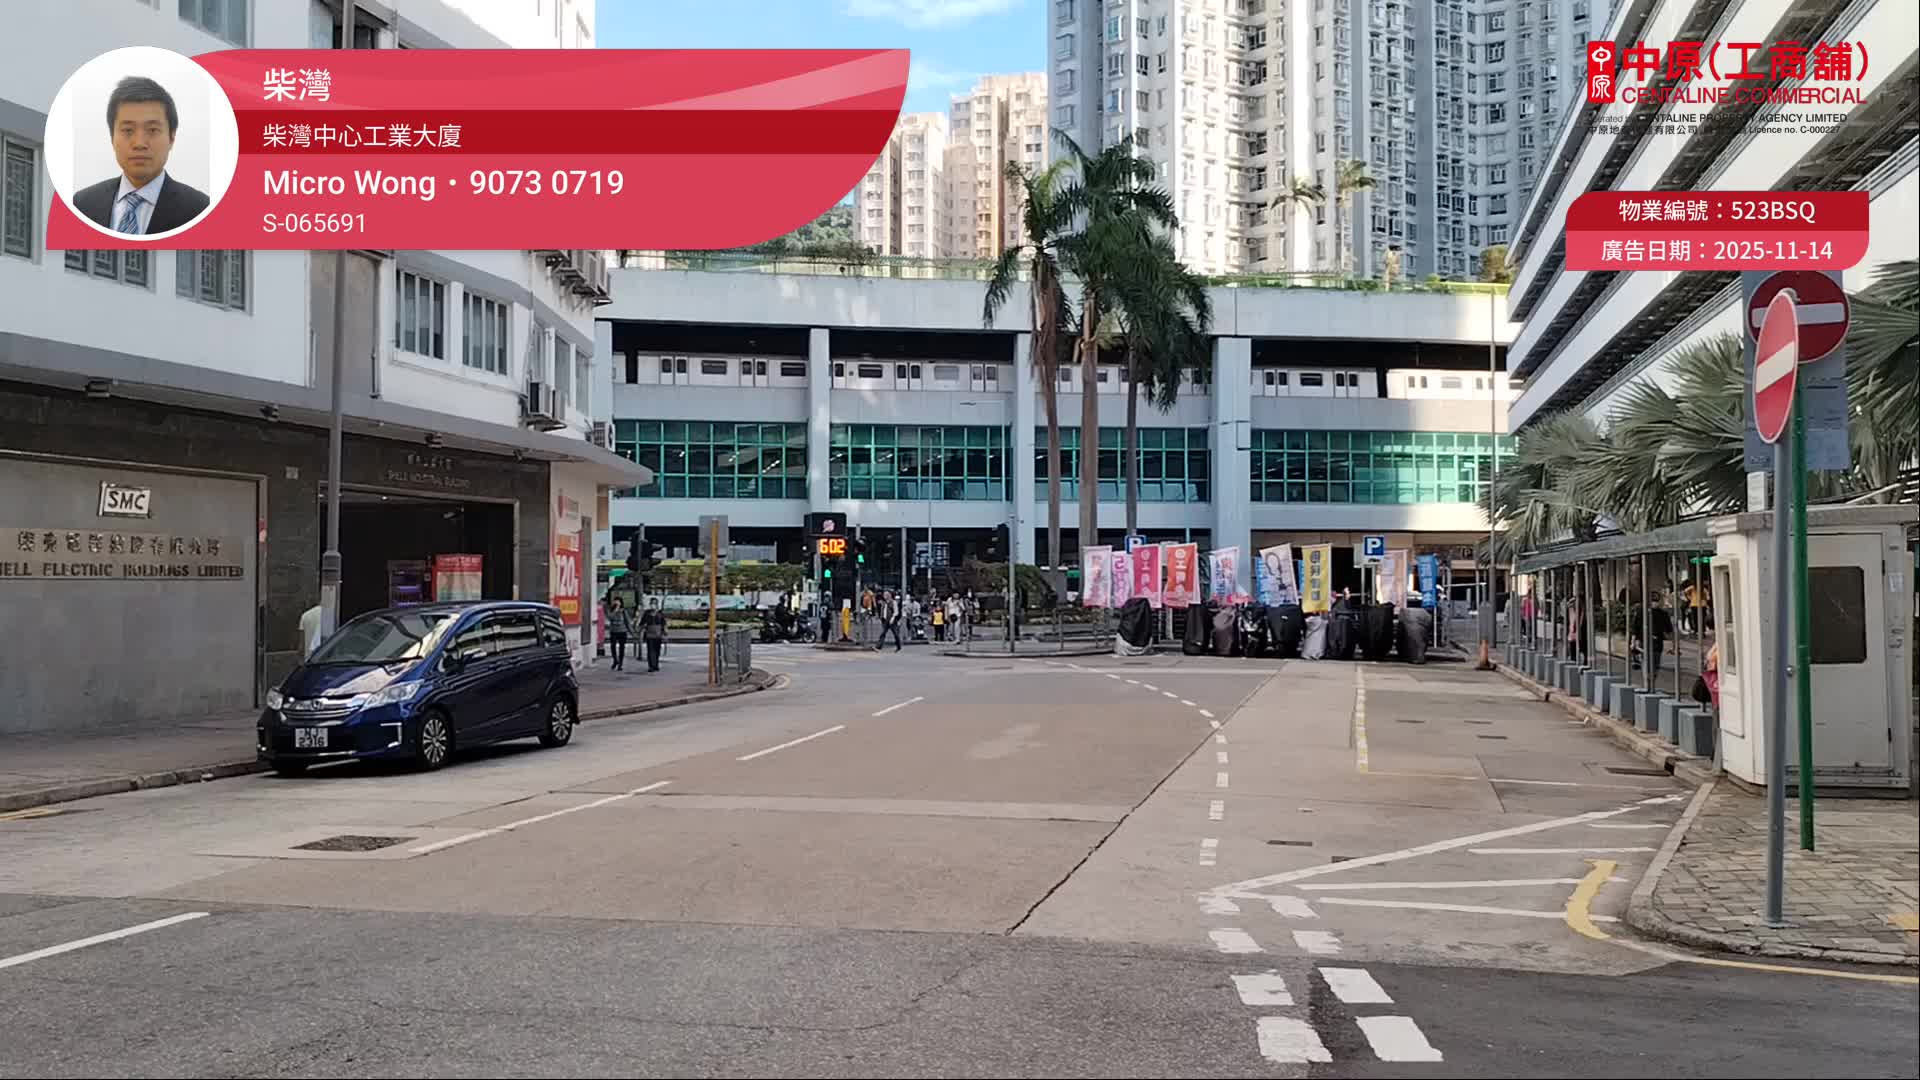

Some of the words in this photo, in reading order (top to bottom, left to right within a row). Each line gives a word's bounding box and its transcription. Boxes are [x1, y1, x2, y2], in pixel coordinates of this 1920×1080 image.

[107, 490, 146, 511] SMC
[1366, 538, 1381, 554] P
[43, 562, 113, 577] ELECTRIC
[197, 564, 244, 577] LIMITED
